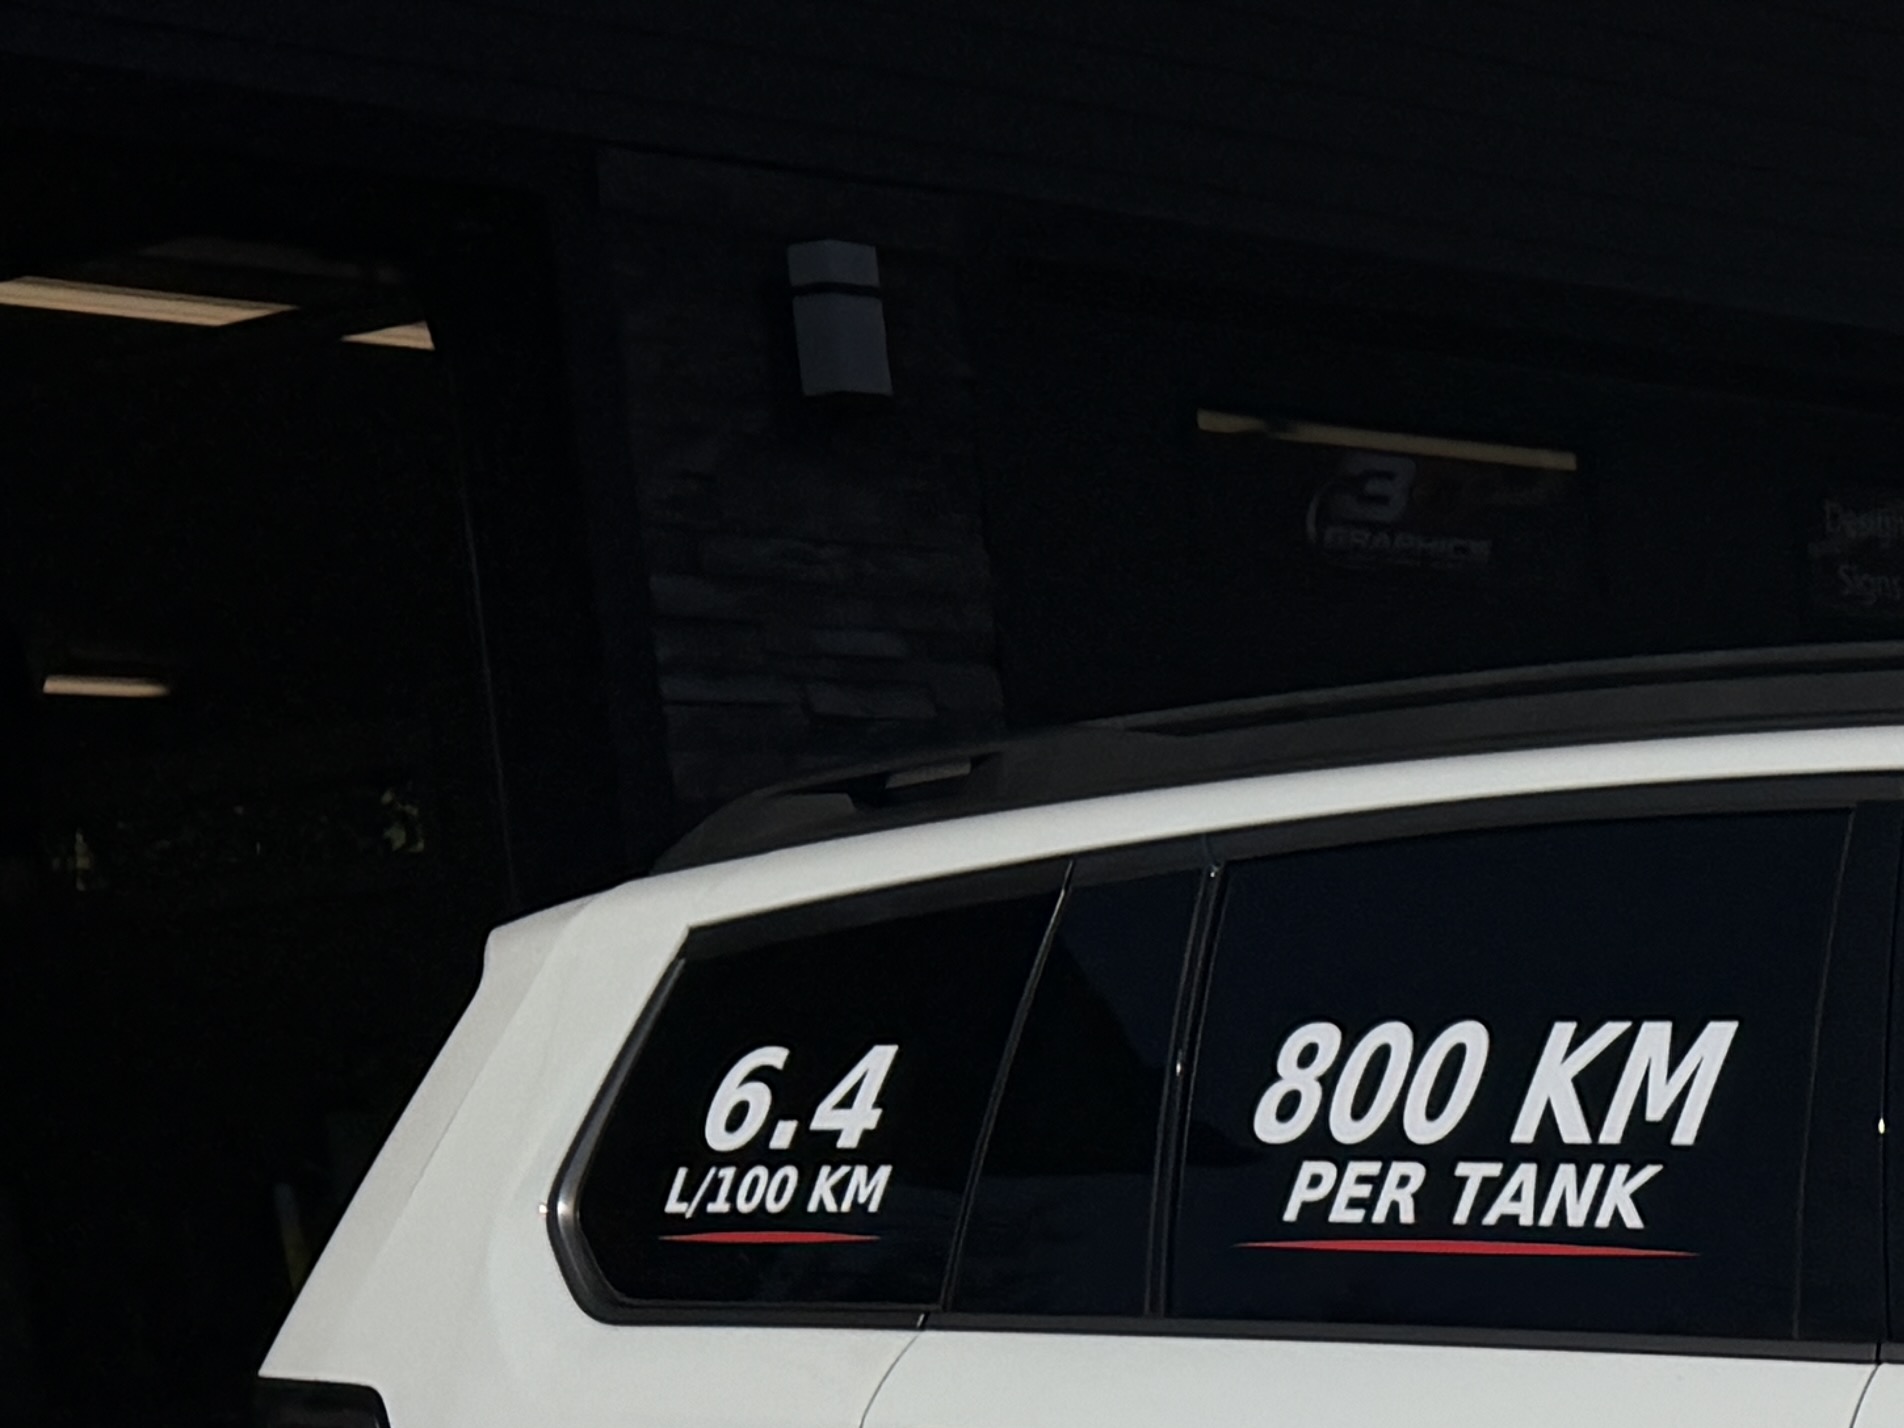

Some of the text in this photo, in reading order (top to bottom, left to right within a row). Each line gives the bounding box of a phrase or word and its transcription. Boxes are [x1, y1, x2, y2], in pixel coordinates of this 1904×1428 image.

[1836, 562, 1904, 607] Signs
[703, 1043, 900, 1153] 6.4
[1252, 1019, 1740, 1147] 800 KM
[663, 1164, 893, 1220] L/100 KM
[1281, 1159, 1665, 1230] PER TANK
